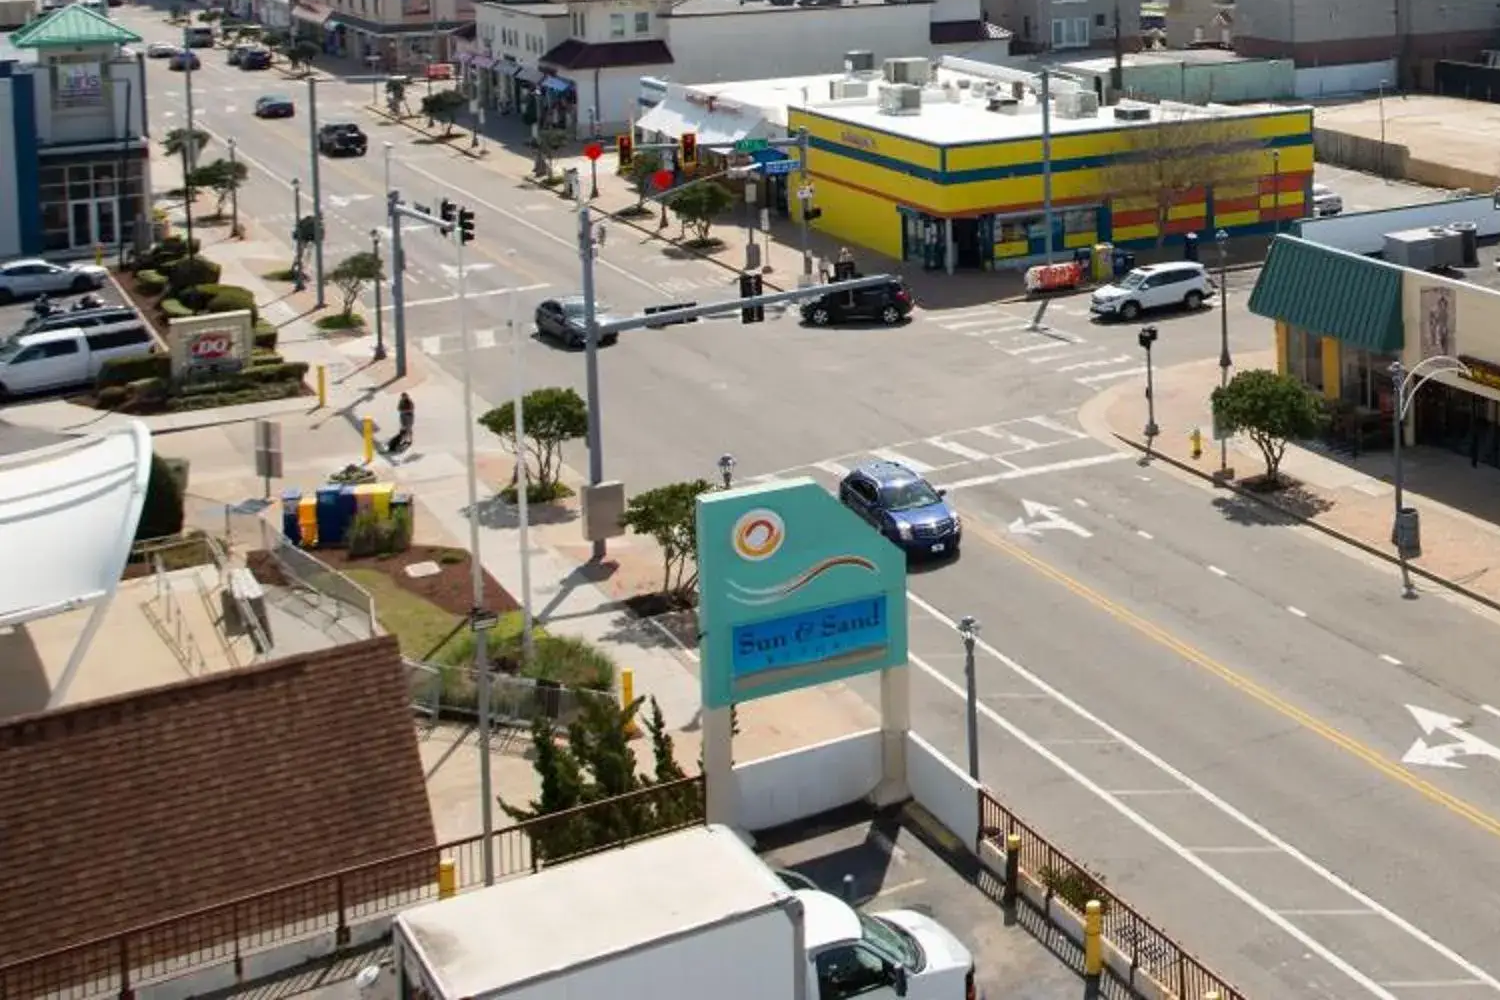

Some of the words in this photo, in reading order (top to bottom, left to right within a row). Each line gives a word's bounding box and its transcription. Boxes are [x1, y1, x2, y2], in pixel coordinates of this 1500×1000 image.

[738, 631, 786, 656] Sun
[793, 620, 814, 644] &
[822, 601, 881, 637] Sand
